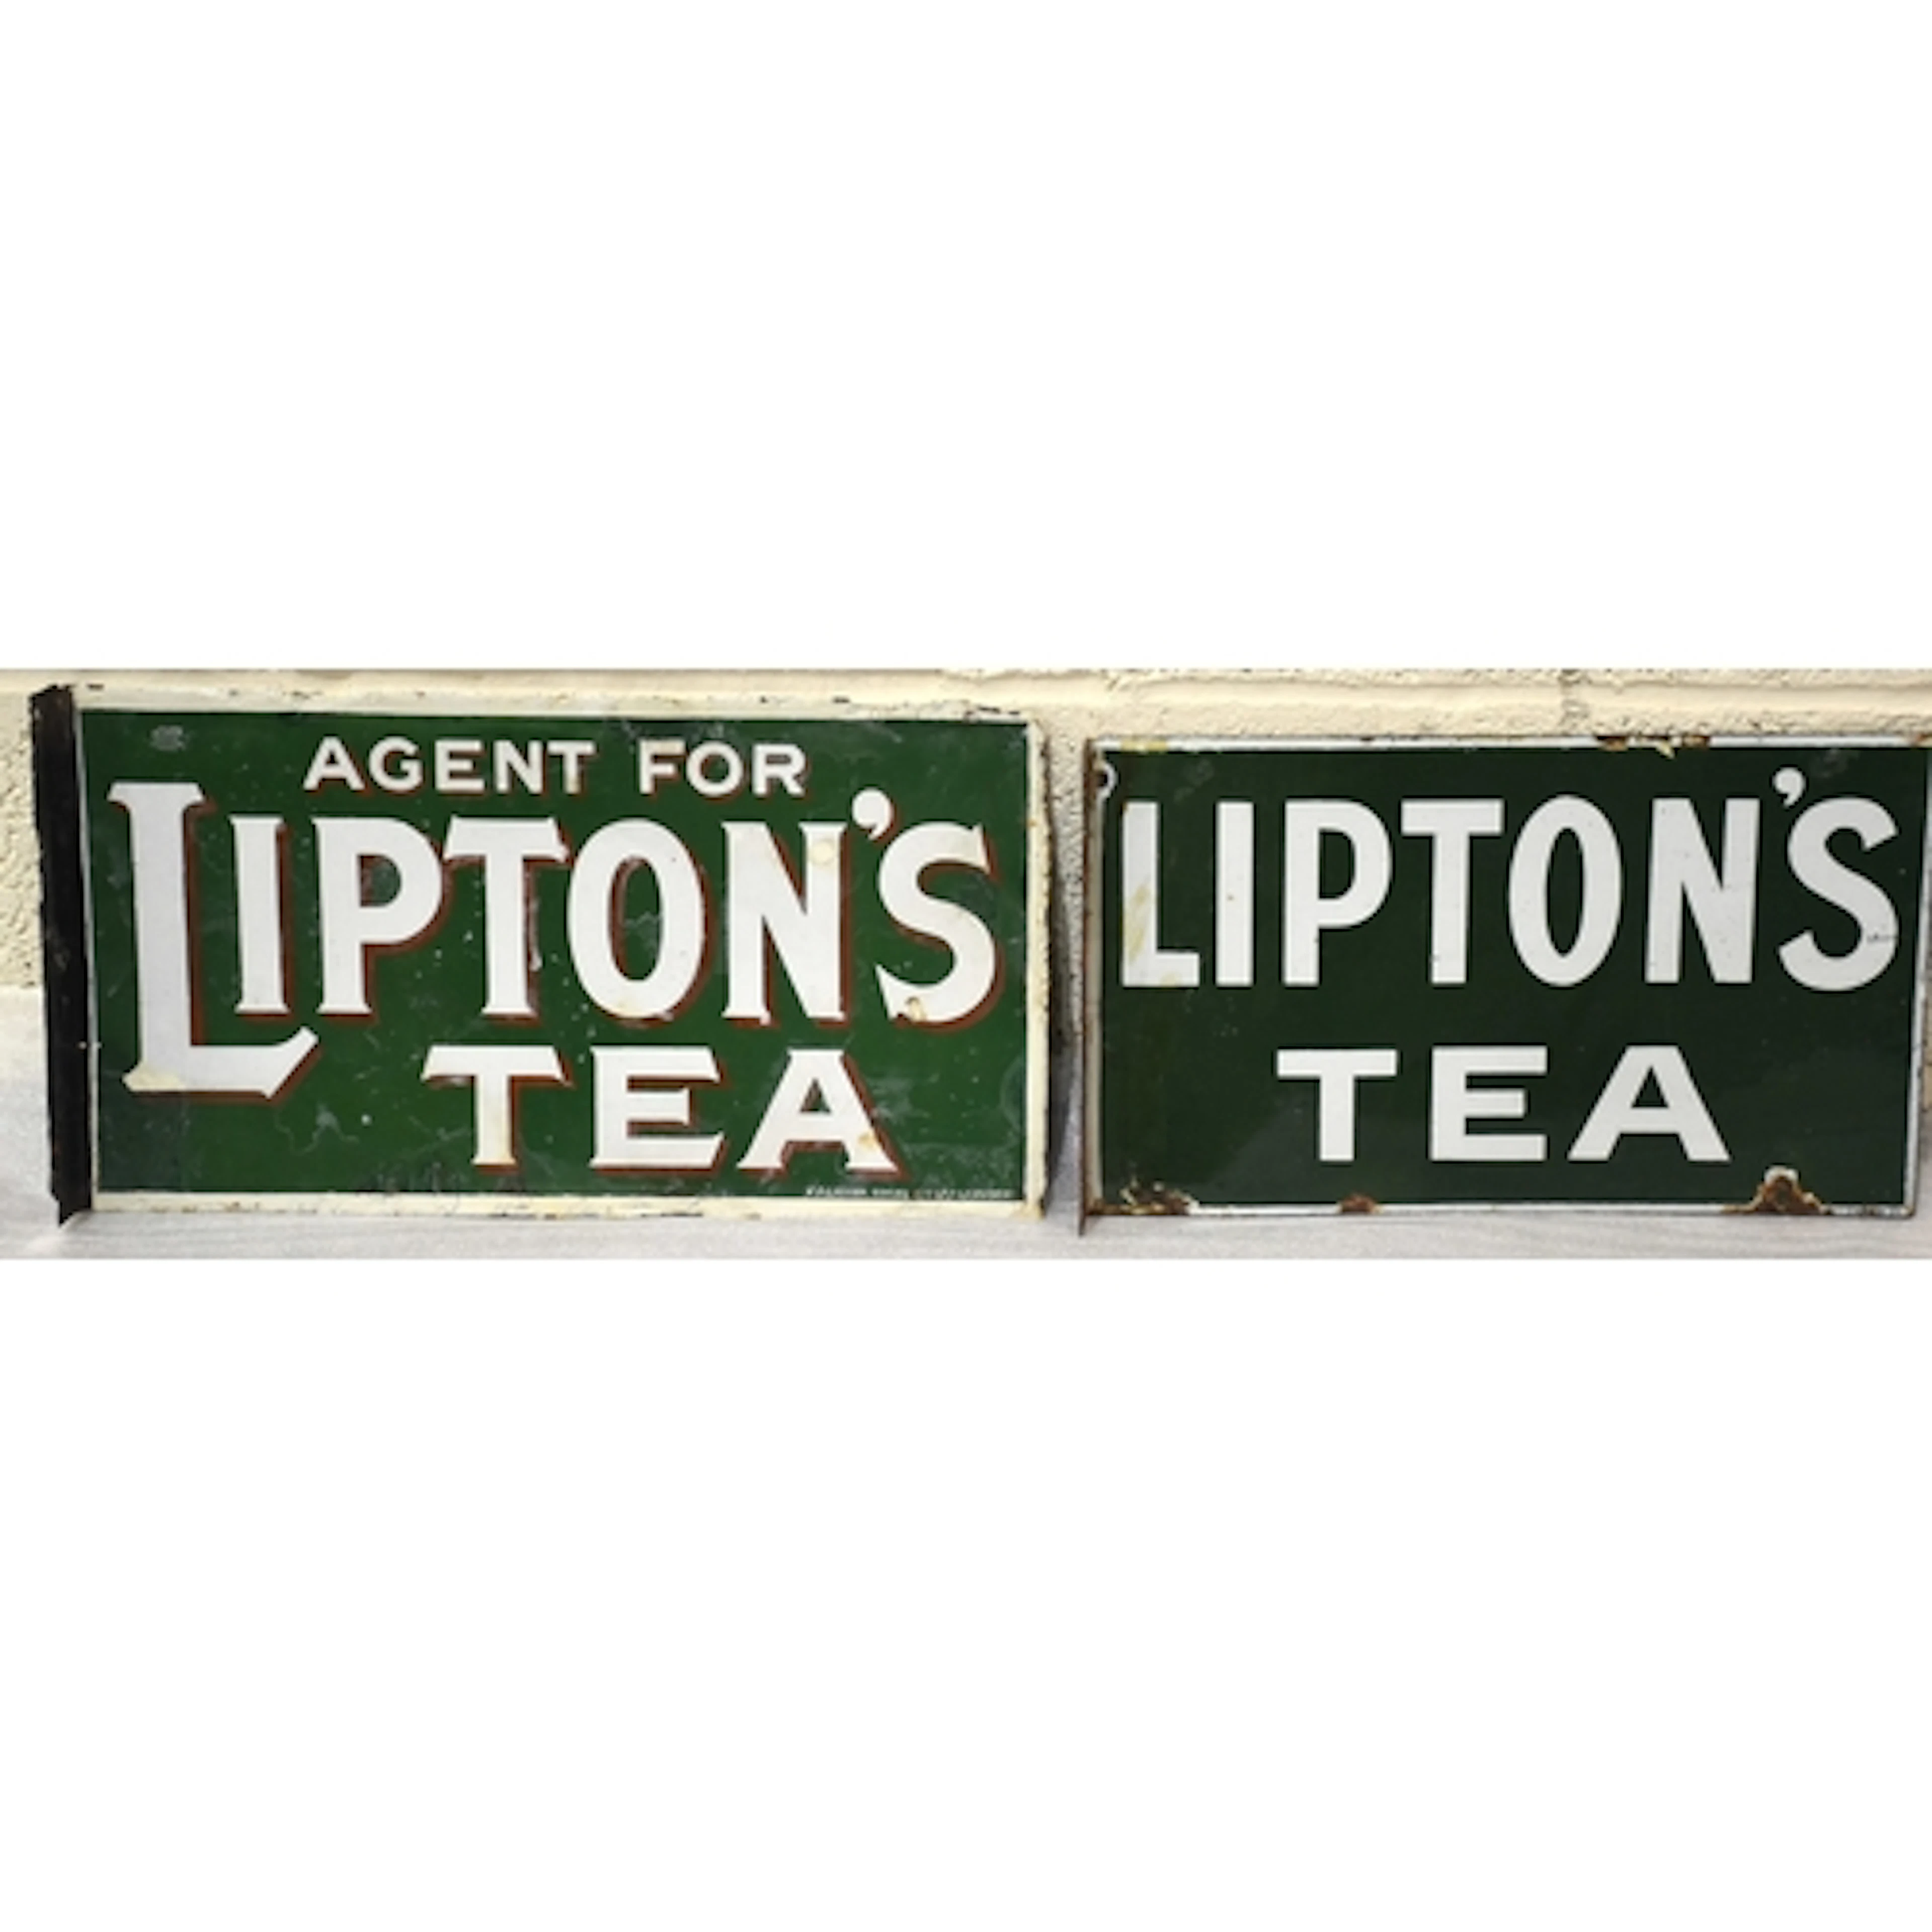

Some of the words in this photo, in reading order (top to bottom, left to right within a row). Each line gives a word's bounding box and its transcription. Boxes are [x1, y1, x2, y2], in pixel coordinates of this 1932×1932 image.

[303, 737, 595, 793] AGENT
[639, 739, 806, 796] FOR
[108, 782, 997, 1098] LIPTON'S
[1121, 768, 1898, 991] LIPTON'S
[421, 1044, 899, 1172] TEA
[1276, 1045, 1730, 1162] TEA
